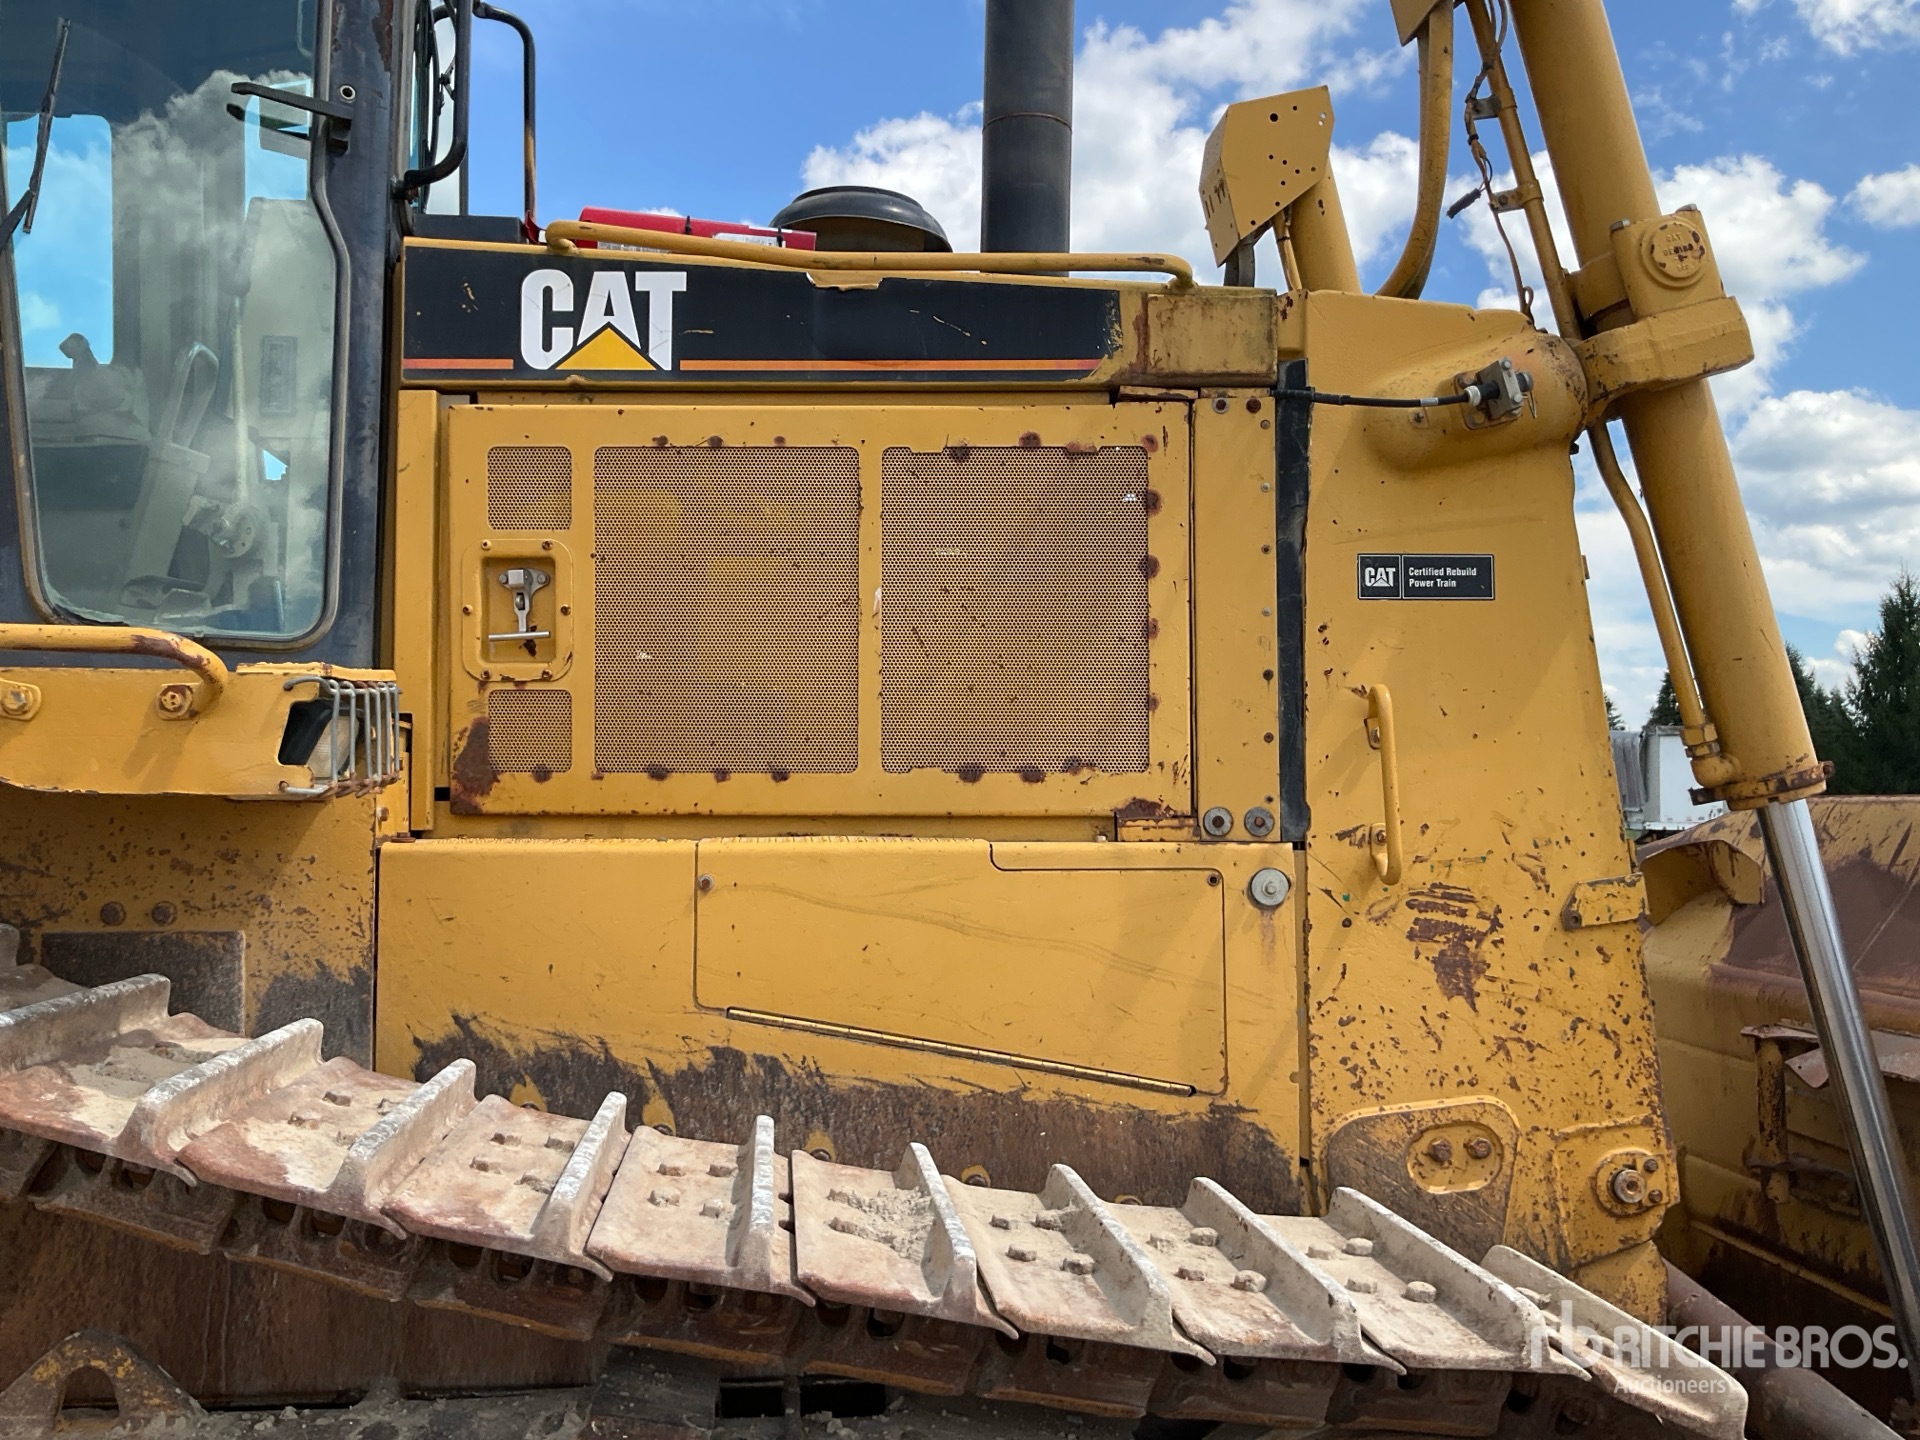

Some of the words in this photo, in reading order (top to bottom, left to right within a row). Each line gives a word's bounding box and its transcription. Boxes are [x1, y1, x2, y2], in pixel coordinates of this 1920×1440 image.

[521, 269, 687, 370] CAT
[1364, 567, 1396, 587] CAT
[1408, 567, 1444, 576] Certified
[1446, 567, 1477, 576] Rebuild
[1409, 579, 1434, 588] Power
[1436, 579, 1457, 588] Train
